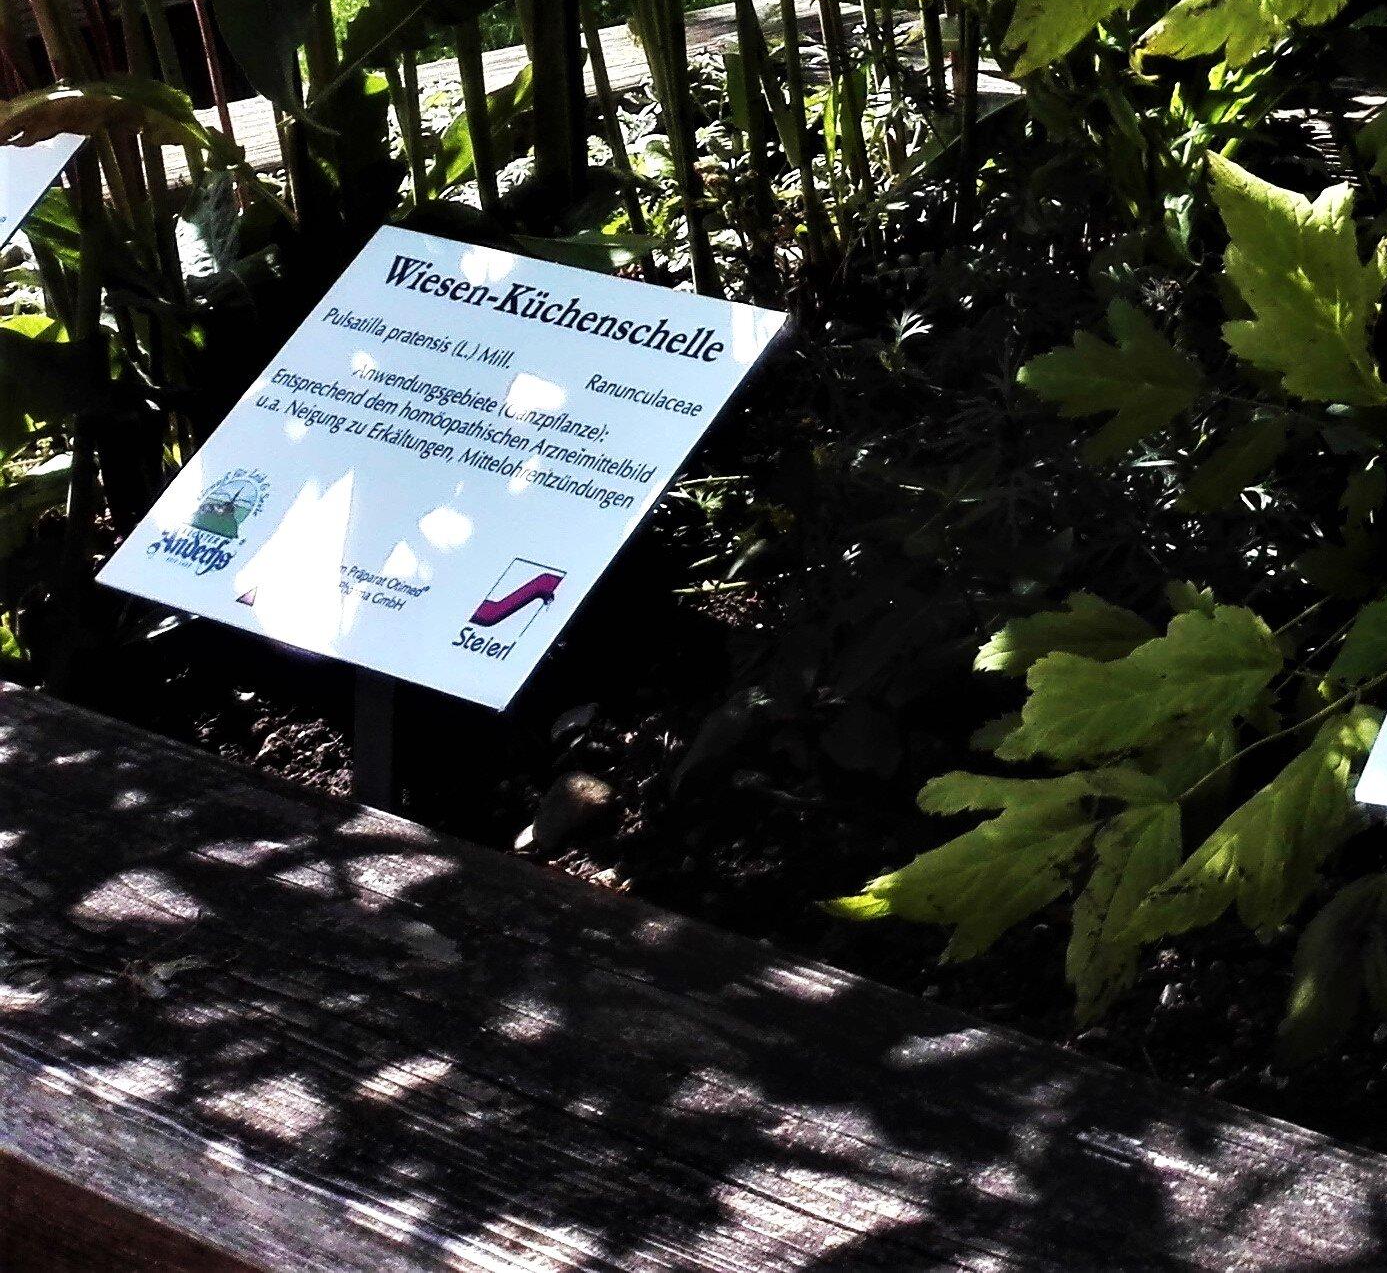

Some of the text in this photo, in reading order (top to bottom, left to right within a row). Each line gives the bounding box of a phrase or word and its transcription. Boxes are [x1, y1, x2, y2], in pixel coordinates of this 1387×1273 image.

[322, 307, 515, 369] Pulsatilla pratensis (L.) Mill.
[384, 255, 724, 362] Wiesen-Küchenschelle
[255, 394, 281, 412] u.a.
[283, 400, 347, 434] Neigung
[345, 420, 369, 435] zu
[367, 422, 454, 463] Erkältungen,
[271, 368, 658, 484] Entsprechend dem homöopathischen Arzneimittelbild
[584, 374, 703, 417] Ranunculaceae
